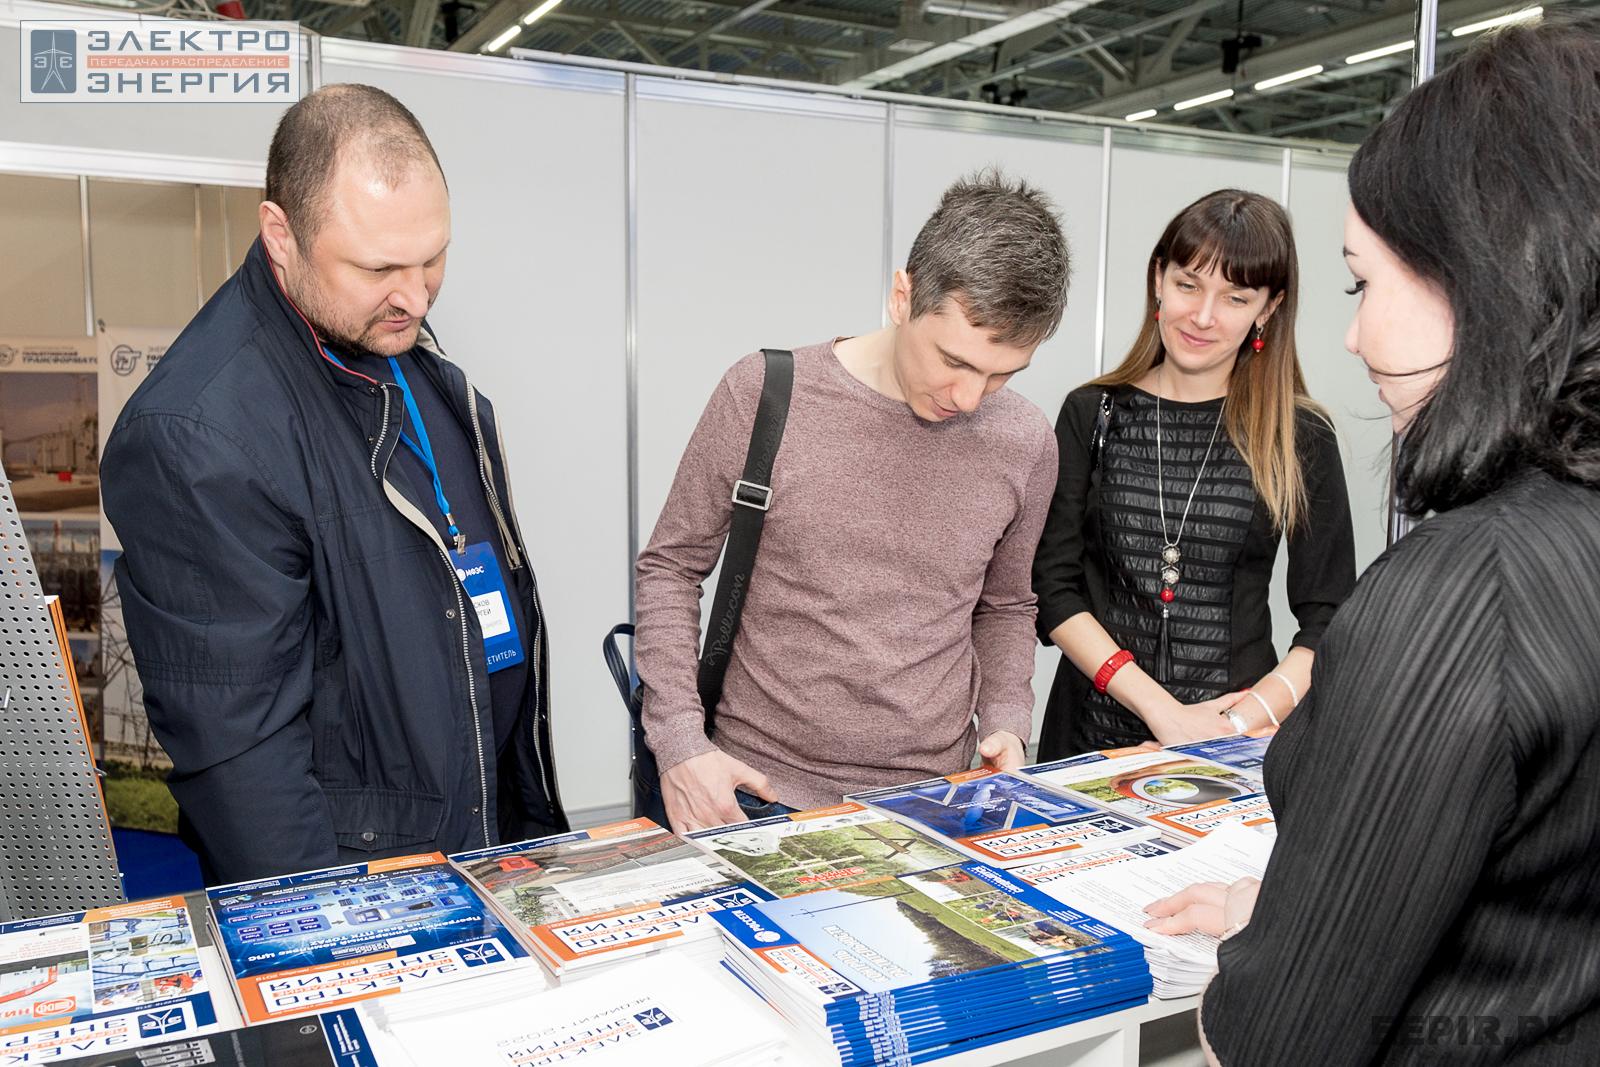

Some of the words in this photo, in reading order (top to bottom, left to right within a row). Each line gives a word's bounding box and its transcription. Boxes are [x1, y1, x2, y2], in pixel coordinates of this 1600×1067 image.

[487, 649, 517, 665] ЕТИТЕЛЬ
[982, 824, 1089, 848] ЭНЕРГИЯ
[999, 831, 1106, 856] ЭЛЕКТРО
[562, 900, 710, 937] ЭНЕРГИЯ
[575, 915, 699, 949] ЛЕКТРО
[731, 909, 765, 933] РОССЕТИ
[246, 951, 276, 962] ЦПС
[270, 951, 448, 992] ЭНЕРГИЯ
[276, 963, 458, 1007] ЭЛЕКТРО
[507, 1020, 632, 1059] ЭНЕРГИЯ
